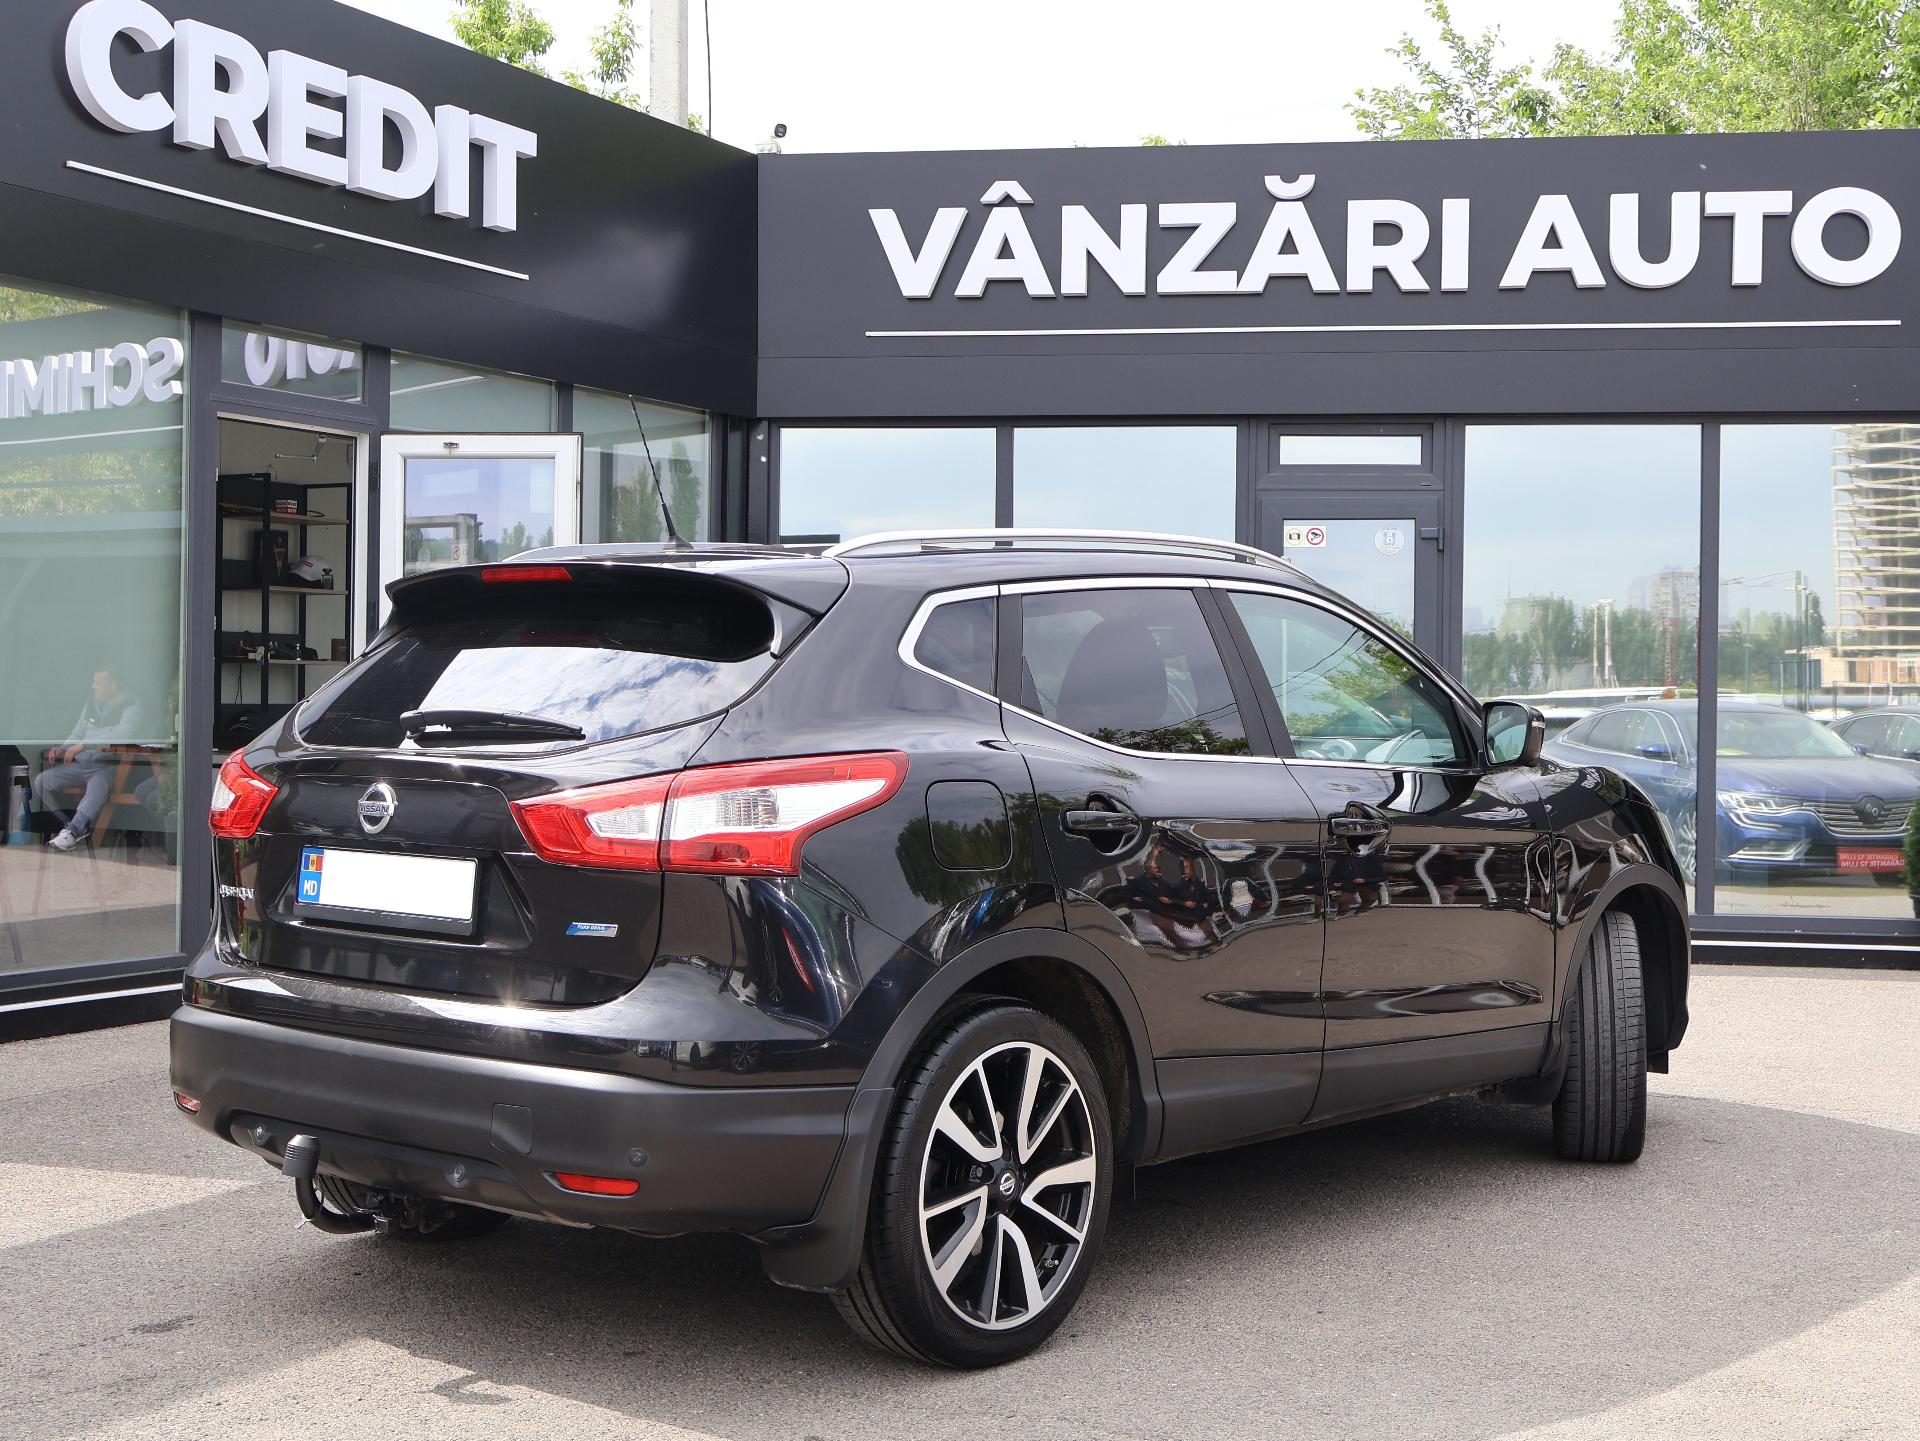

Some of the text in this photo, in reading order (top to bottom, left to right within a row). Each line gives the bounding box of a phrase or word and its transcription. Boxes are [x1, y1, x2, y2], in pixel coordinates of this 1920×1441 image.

[65, 0, 538, 233] CREDIT
[868, 174, 1903, 298] VÂNZĂRI AUTO
[358, 803, 390, 814] NISSAN
[303, 879, 318, 896] MD
